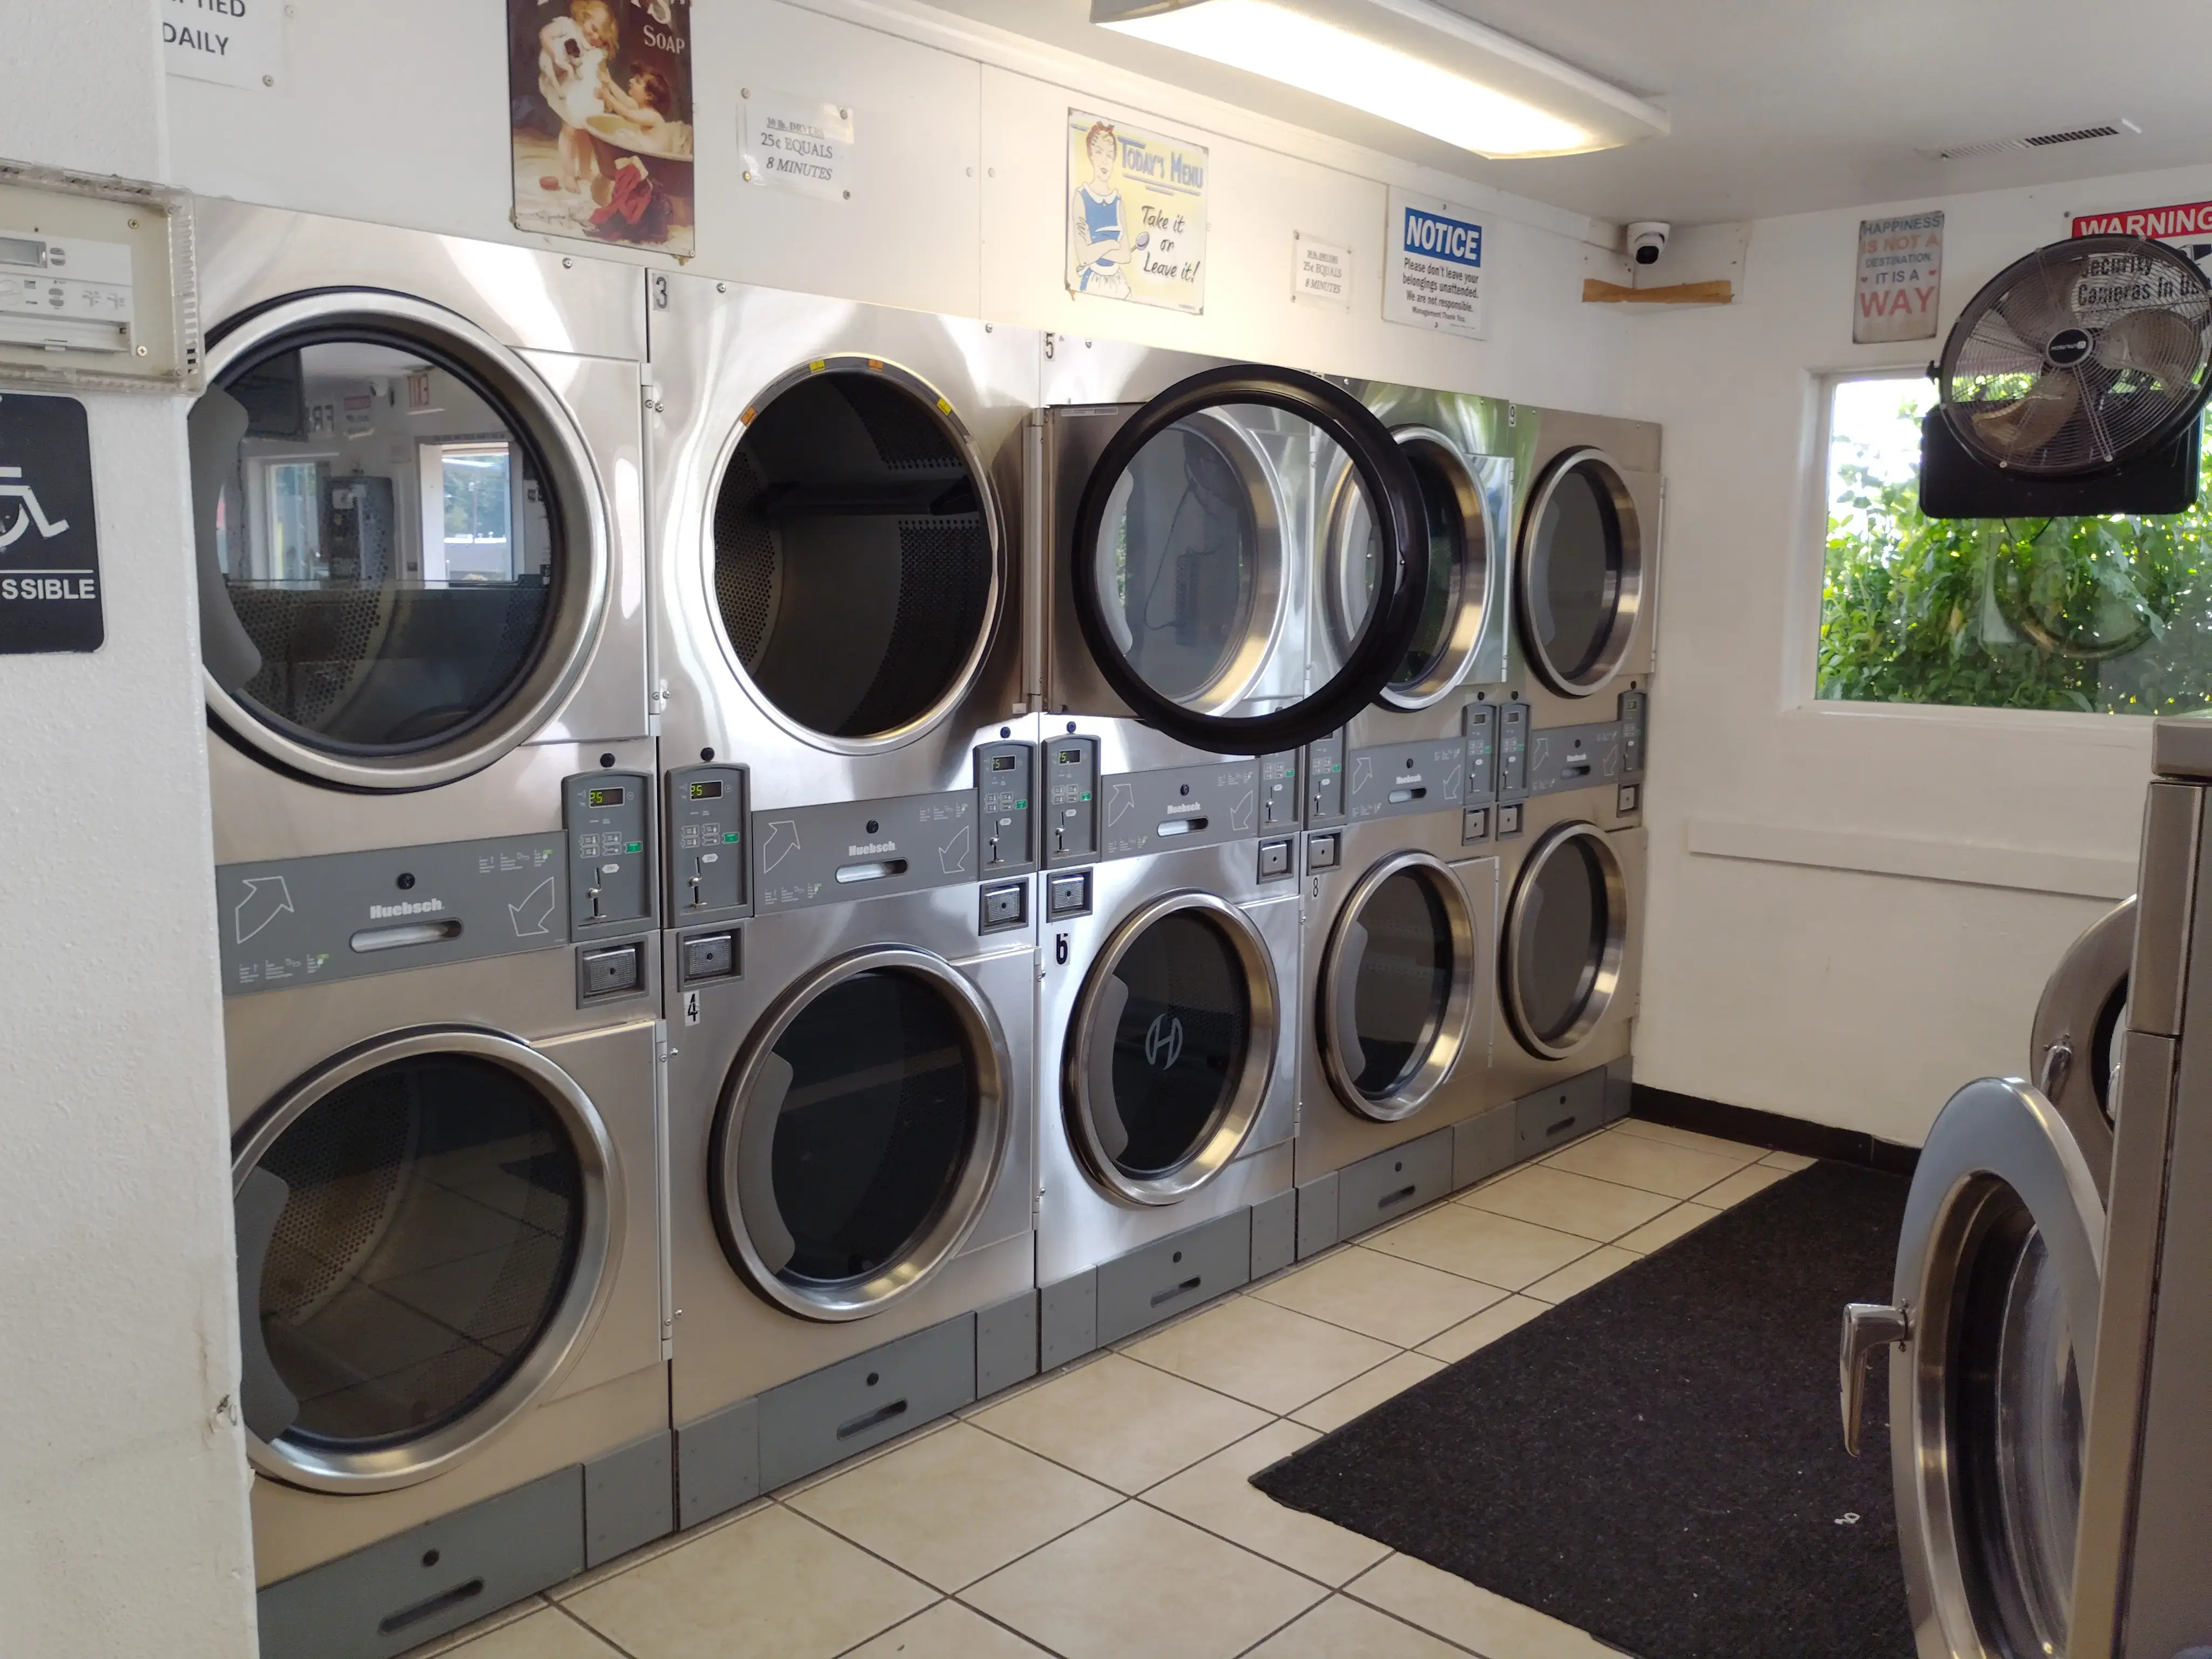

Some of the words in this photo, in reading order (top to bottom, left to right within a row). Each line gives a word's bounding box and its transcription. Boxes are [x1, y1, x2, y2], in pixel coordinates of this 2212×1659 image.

[163, 22, 229, 56] DAILY
[643, 24, 685, 54] SOAP
[761, 132, 781, 150] 25¢
[785, 137, 833, 159] EQUALS
[766, 157, 774, 168] 8
[776, 158, 833, 180] MINUTES
[1142, 206, 1169, 229] Take
[1173, 214, 1185, 233] it
[1864, 217, 1940, 235] HAPPINESS
[2080, 206, 2212, 236] WARNING
[1160, 239, 1175, 252] or
[1406, 215, 1479, 260] NOTICE
[1884, 234, 1921, 252] NOT
[1925, 231, 1940, 247] A
[1143, 252, 1177, 278] Leave
[1181, 261, 1201, 283] it!
[1316, 264, 1341, 278] EQUALS
[1404, 257, 1426, 273] Please
[1427, 263, 1444, 277] don't
[1446, 267, 1463, 281] leave
[1464, 273, 1480, 285] your
[1876, 272, 1889, 285] IT
[1892, 271, 1905, 283] IS
[1909, 269, 1919, 281] A
[656, 276, 667, 309] 3
[1305, 278, 1310, 287] 8
[1310, 279, 1341, 294] MINUTES
[1402, 272, 1438, 292] belongings
[1439, 283, 1479, 299] unattended.
[2079, 284, 2150, 306] Cameras
[1406, 289, 1415, 301] We
[1417, 294, 1426, 304] are
[1427, 296, 1438, 306] not
[1438, 299, 1473, 313] responsible.
[1860, 286, 1936, 318] WAY
[1046, 333, 1054, 360] 5
[1510, 406, 1515, 424] 9
[848, 840, 895, 857] Huebsch
[1313, 877, 1318, 898] 8
[370, 898, 442, 919] Huebsch
[1056, 933, 1068, 965] 6
[687, 994, 698, 1022] 4
